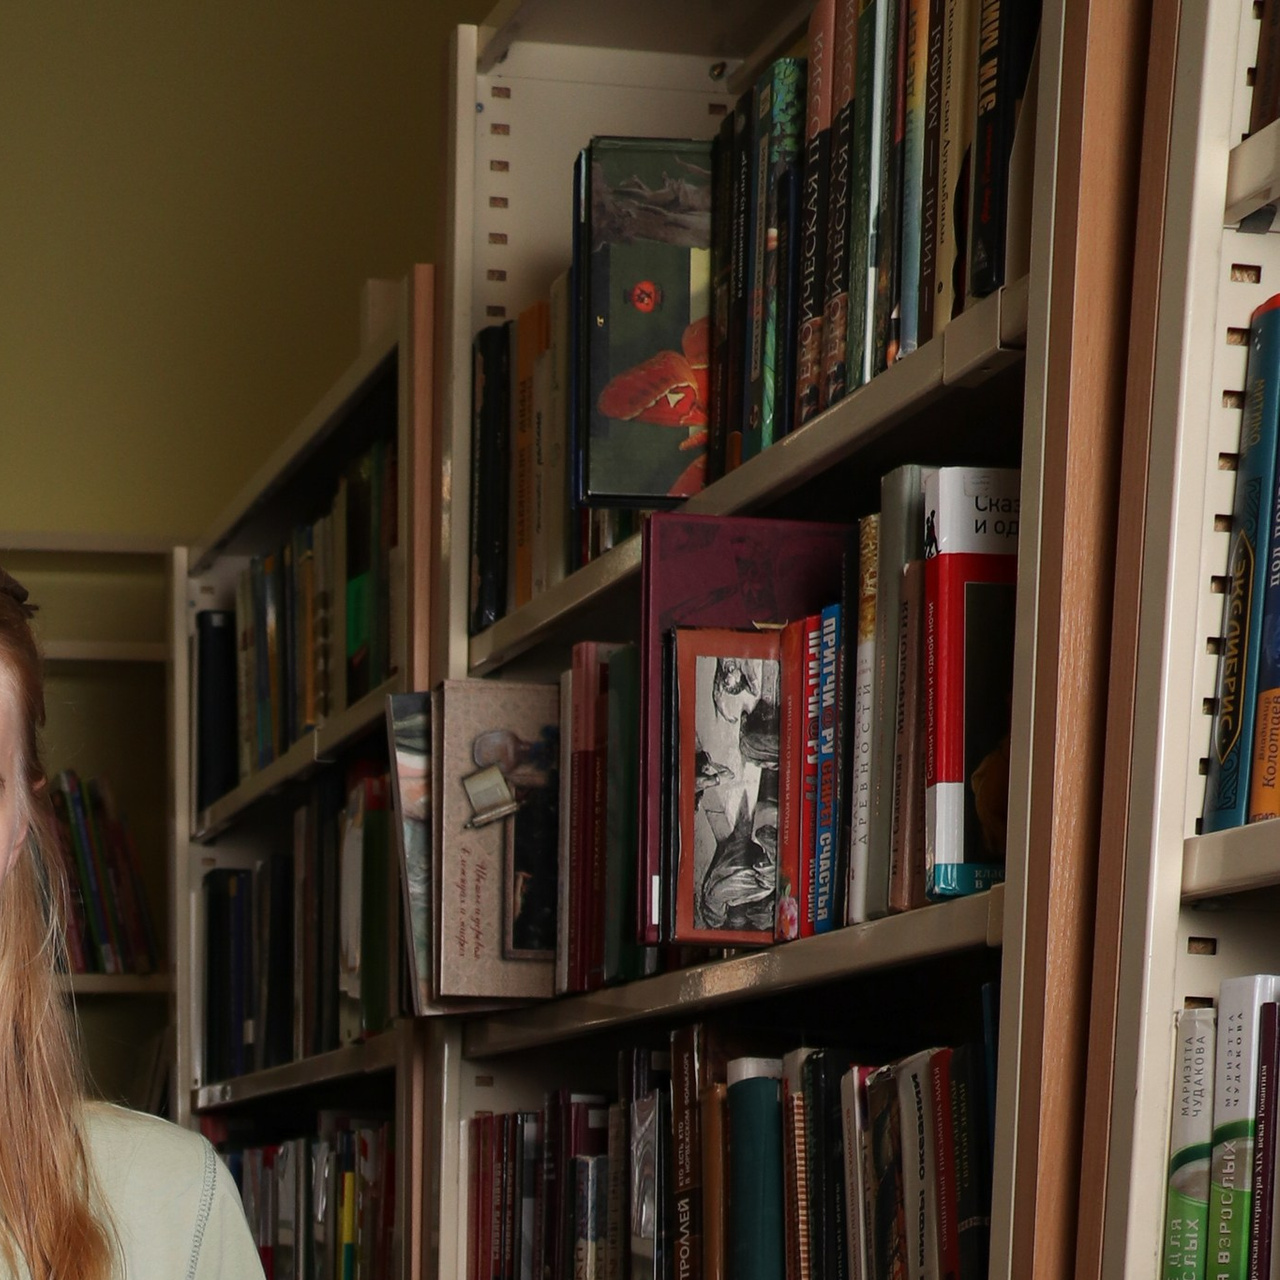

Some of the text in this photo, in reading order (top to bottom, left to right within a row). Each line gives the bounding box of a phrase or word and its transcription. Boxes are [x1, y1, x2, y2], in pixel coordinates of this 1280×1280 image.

[926, 24, 942, 130] МИФЫ
[978, 56, 998, 116] ЭТИ
[798, 30, 825, 396] ГЕРОИЧЕСКАЯ ПОЭЗИЯ
[922, 187, 935, 277] ГИГИН
[826, 142, 849, 373] ГЕРОИЧЕСКАЯ
[1249, 379, 1265, 446] МИТИКО
[896, 599, 909, 734] МИФОЛОГИЯ
[927, 635, 936, 674] одной
[927, 688, 935, 732] тысячи
[1257, 697, 1271, 762] Владимир
[1262, 695, 1280, 789] Колотаев
[819, 760, 834, 827] СЕКРЕТ
[858, 681, 872, 845] ДРЕВНОСТИ
[926, 734, 935, 780] Сказки
[816, 832, 832, 921] СЧАСТЬЯ
[682, 1051, 690, 1105] ФОЛЬКЛОРЕ
[1180, 1035, 1194, 1117] МАРИЭТТА
[1191, 1035, 1206, 1117] ЧУДАКОВА
[1224, 1014, 1235, 1107] МАРИЭТТА
[1233, 1012, 1244, 1107] ЧУДАКОВА
[1257, 1064, 1269, 1117] Романтизм
[933, 1066, 949, 1252] СВЯЩЕННЫЕ ПИСЬМЕНА МАЙЯ
[1254, 1151, 1265, 1173] XIX
[1256, 1120, 1267, 1149] века.
[677, 1197, 691, 1278] ТРОЛЛЕЙ
[1166, 1217, 1183, 1267] ДЛЯ
[1218, 1140, 1237, 1265] ВЗРОСЛЫХ
[1251, 1176, 1265, 1239] литература
